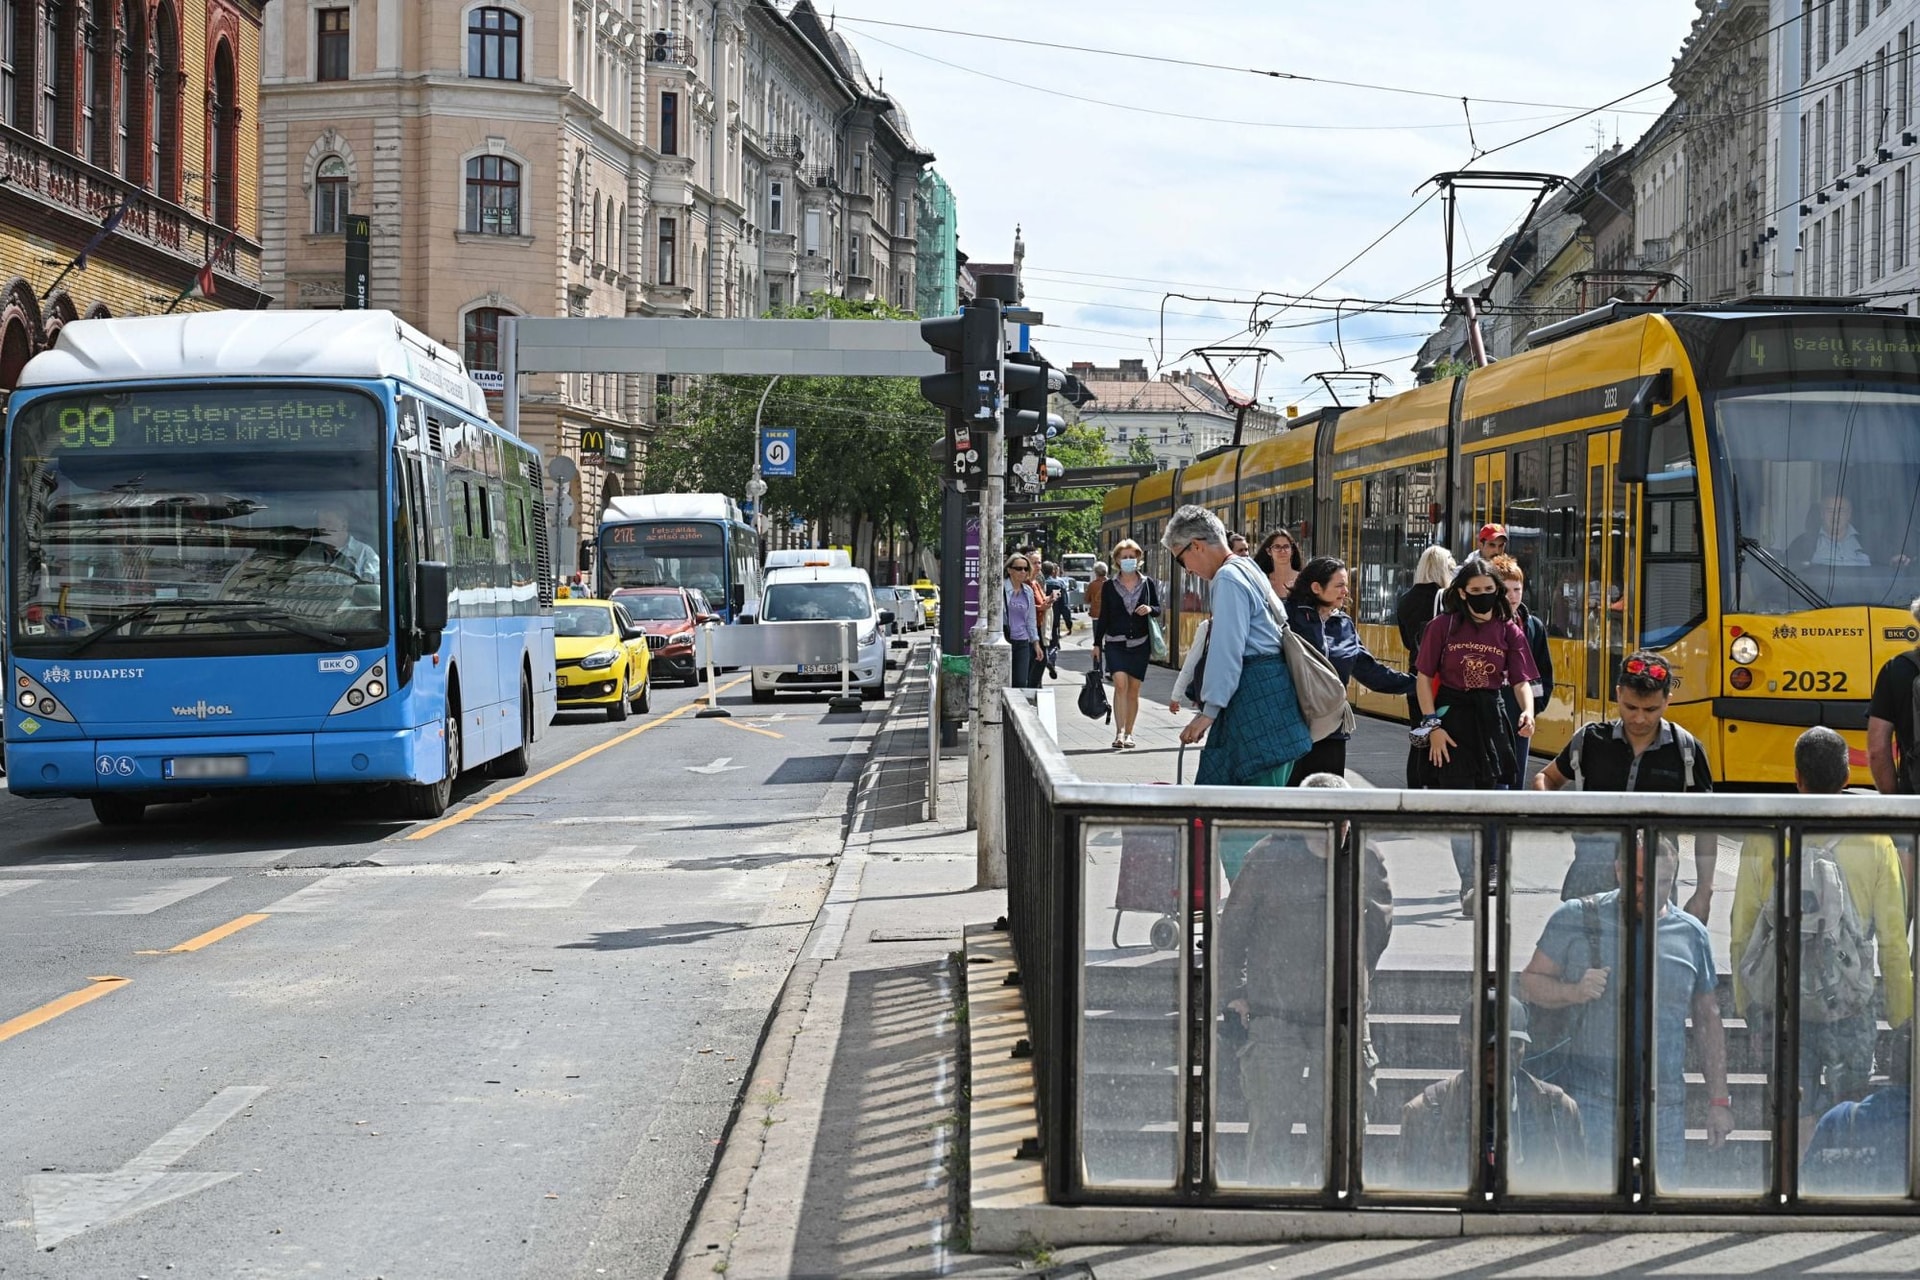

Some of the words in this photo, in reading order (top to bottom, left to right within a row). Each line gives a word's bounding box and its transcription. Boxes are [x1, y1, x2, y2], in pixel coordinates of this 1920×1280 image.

[1750, 335, 1766, 367] 4
[1793, 336, 1844, 351] Széll
[1851, 337, 1920, 353] Kálmán
[1832, 353, 1862, 367] tér
[1870, 355, 1883, 368] M
[474, 372, 504, 381] ELADÓ
[1604, 387, 1618, 409] 2032
[132, 400, 357, 424] Pesterzsébet,
[59, 406, 115, 448] 99
[145, 423, 228, 444] Mátyás
[236, 421, 302, 442] király
[309, 419, 345, 438] tér
[614, 527, 636, 544] 217E
[1801, 628, 1865, 637] BUDAPEST
[1887, 630, 1905, 638] BKK
[1447, 641, 1505, 657] Gyerekegyete
[323, 661, 342, 669] BKK
[74, 668, 145, 680] BUDAPEST
[1782, 671, 1848, 692] 2032
